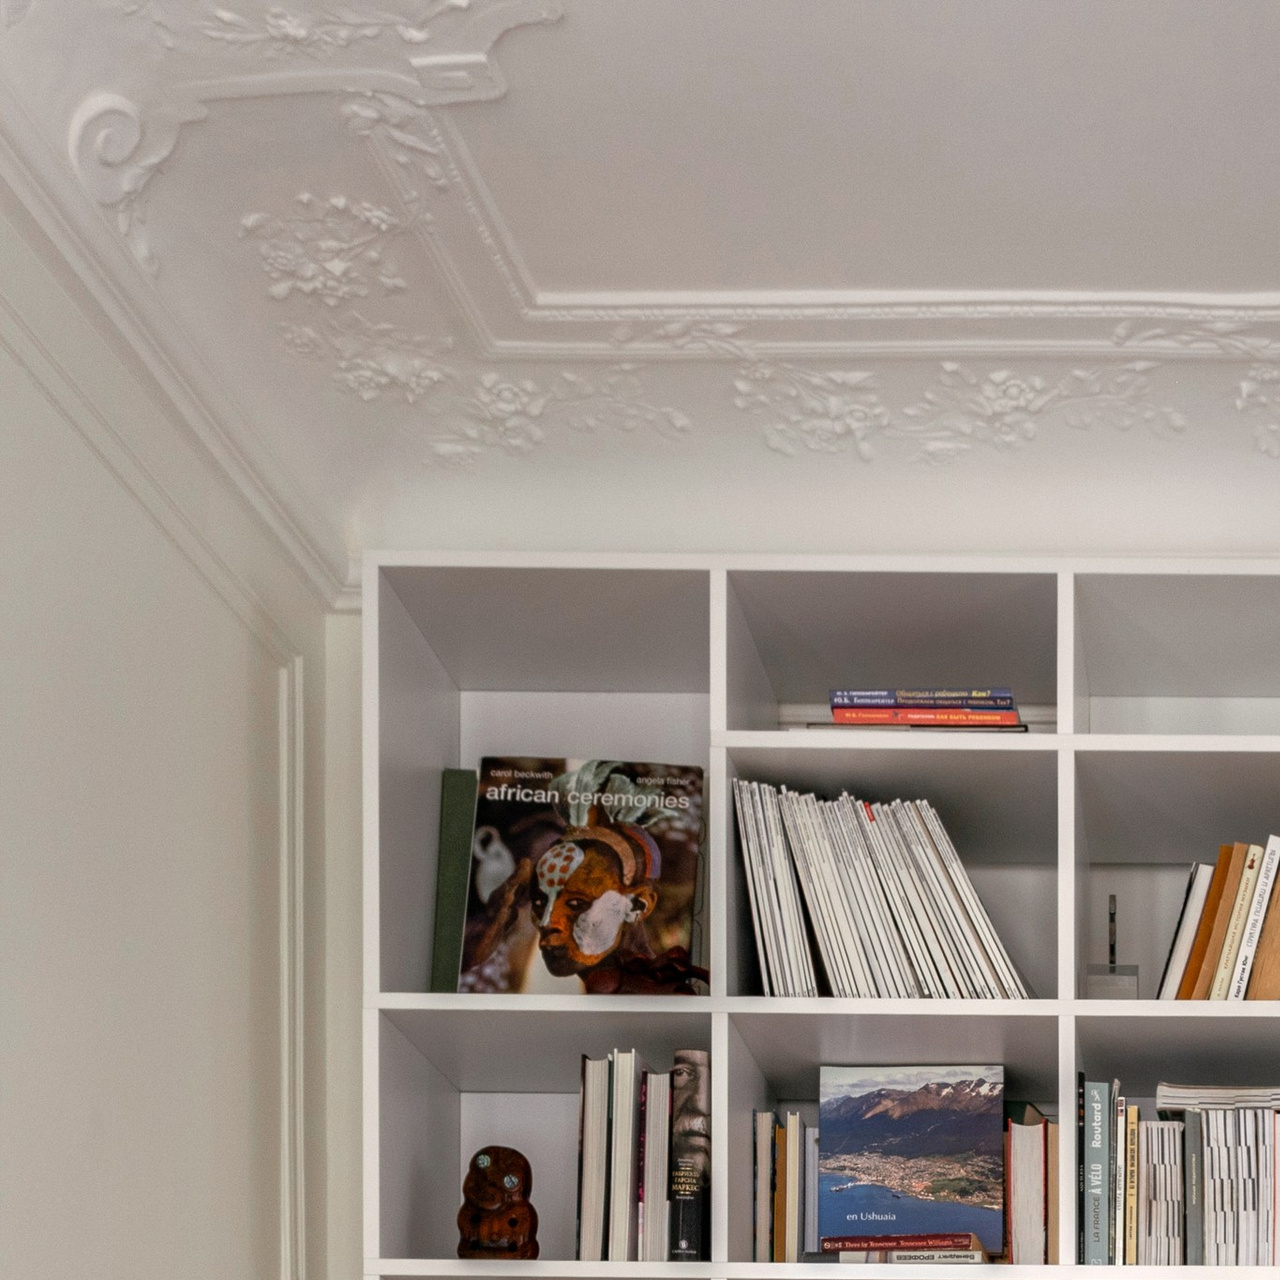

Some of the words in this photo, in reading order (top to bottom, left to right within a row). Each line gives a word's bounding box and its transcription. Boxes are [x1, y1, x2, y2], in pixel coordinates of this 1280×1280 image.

[490, 769, 512, 778] carol
[513, 769, 553, 779] beckwith
[636, 776, 665, 786] angela
[666, 777, 690, 786] fisher
[486, 784, 559, 803] african
[567, 790, 690, 808] ceremonies
[1246, 918, 1260, 948] СТРУКТУРА
[1254, 888, 1267, 917] ПСИХИКИ
[1262, 849, 1276, 880] АРХЕТИПЫ
[1241, 955, 1249, 967] Юнг
[1237, 967, 1246, 985] Густав
[1234, 985, 1242, 998] Карл
[1092, 1103, 1102, 1148] Routard
[1088, 1163, 1102, 1185] VÉLO
[846, 1213, 858, 1221] en
[860, 1211, 896, 1221] Ushuaia
[1093, 1196, 1101, 1230] FRANCE
[1093, 1230, 1101, 1243] LA
